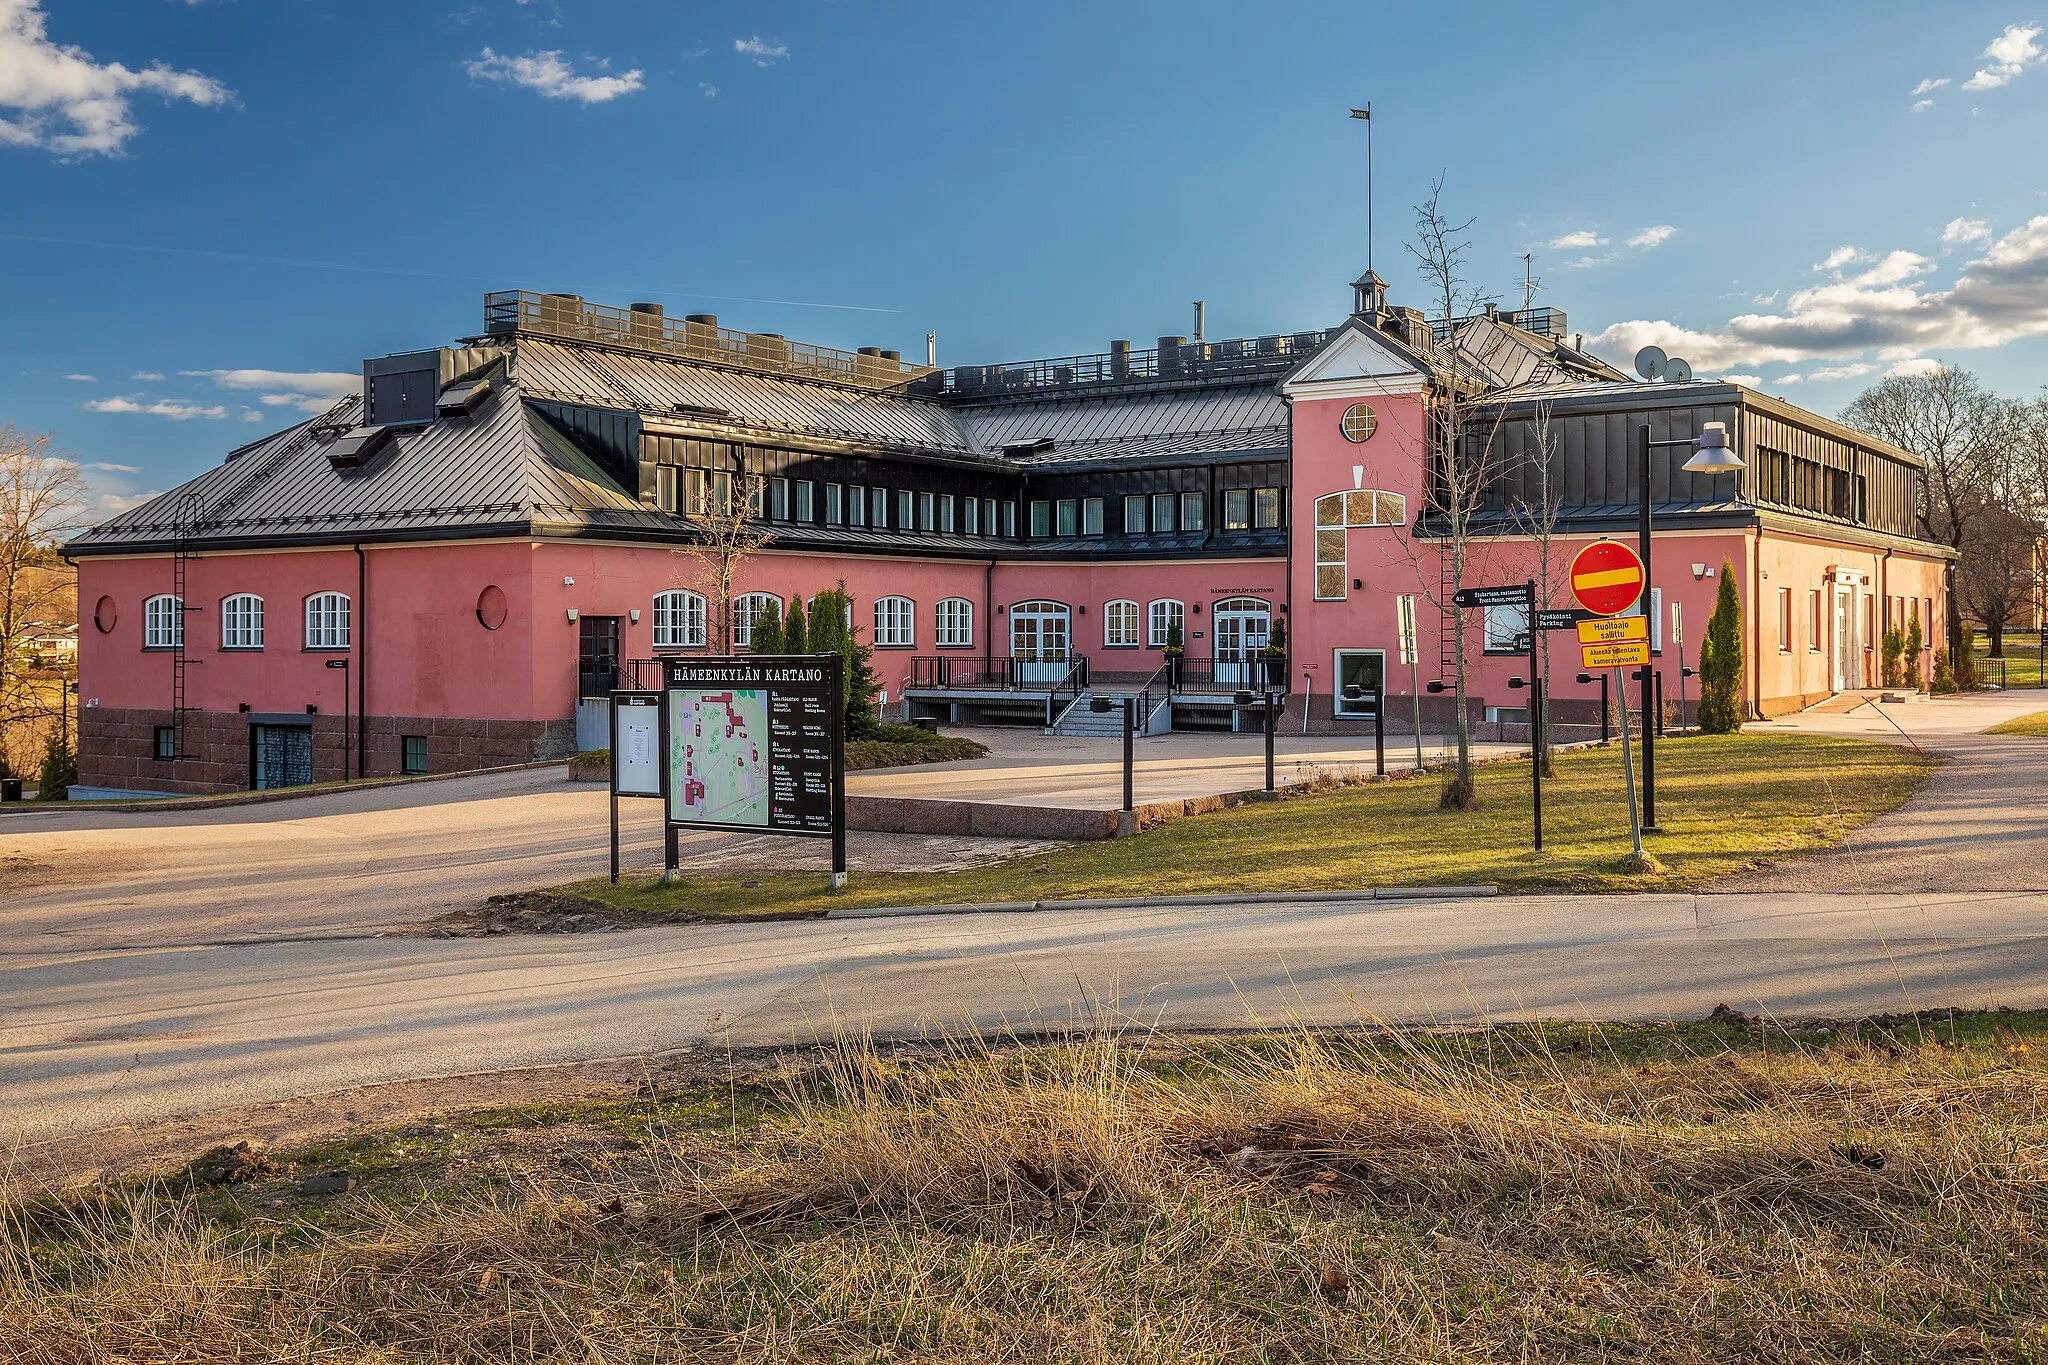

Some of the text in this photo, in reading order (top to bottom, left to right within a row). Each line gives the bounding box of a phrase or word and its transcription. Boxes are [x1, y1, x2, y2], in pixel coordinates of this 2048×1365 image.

[1594, 621, 1629, 631] Huoltoajo
[1600, 631, 1625, 639] sallittu
[1589, 647, 1612, 656] Alueella
[1593, 656, 1638, 665] kameravalvonta
[673, 666, 822, 682] HÄMEENKYLÄN KARTANO
